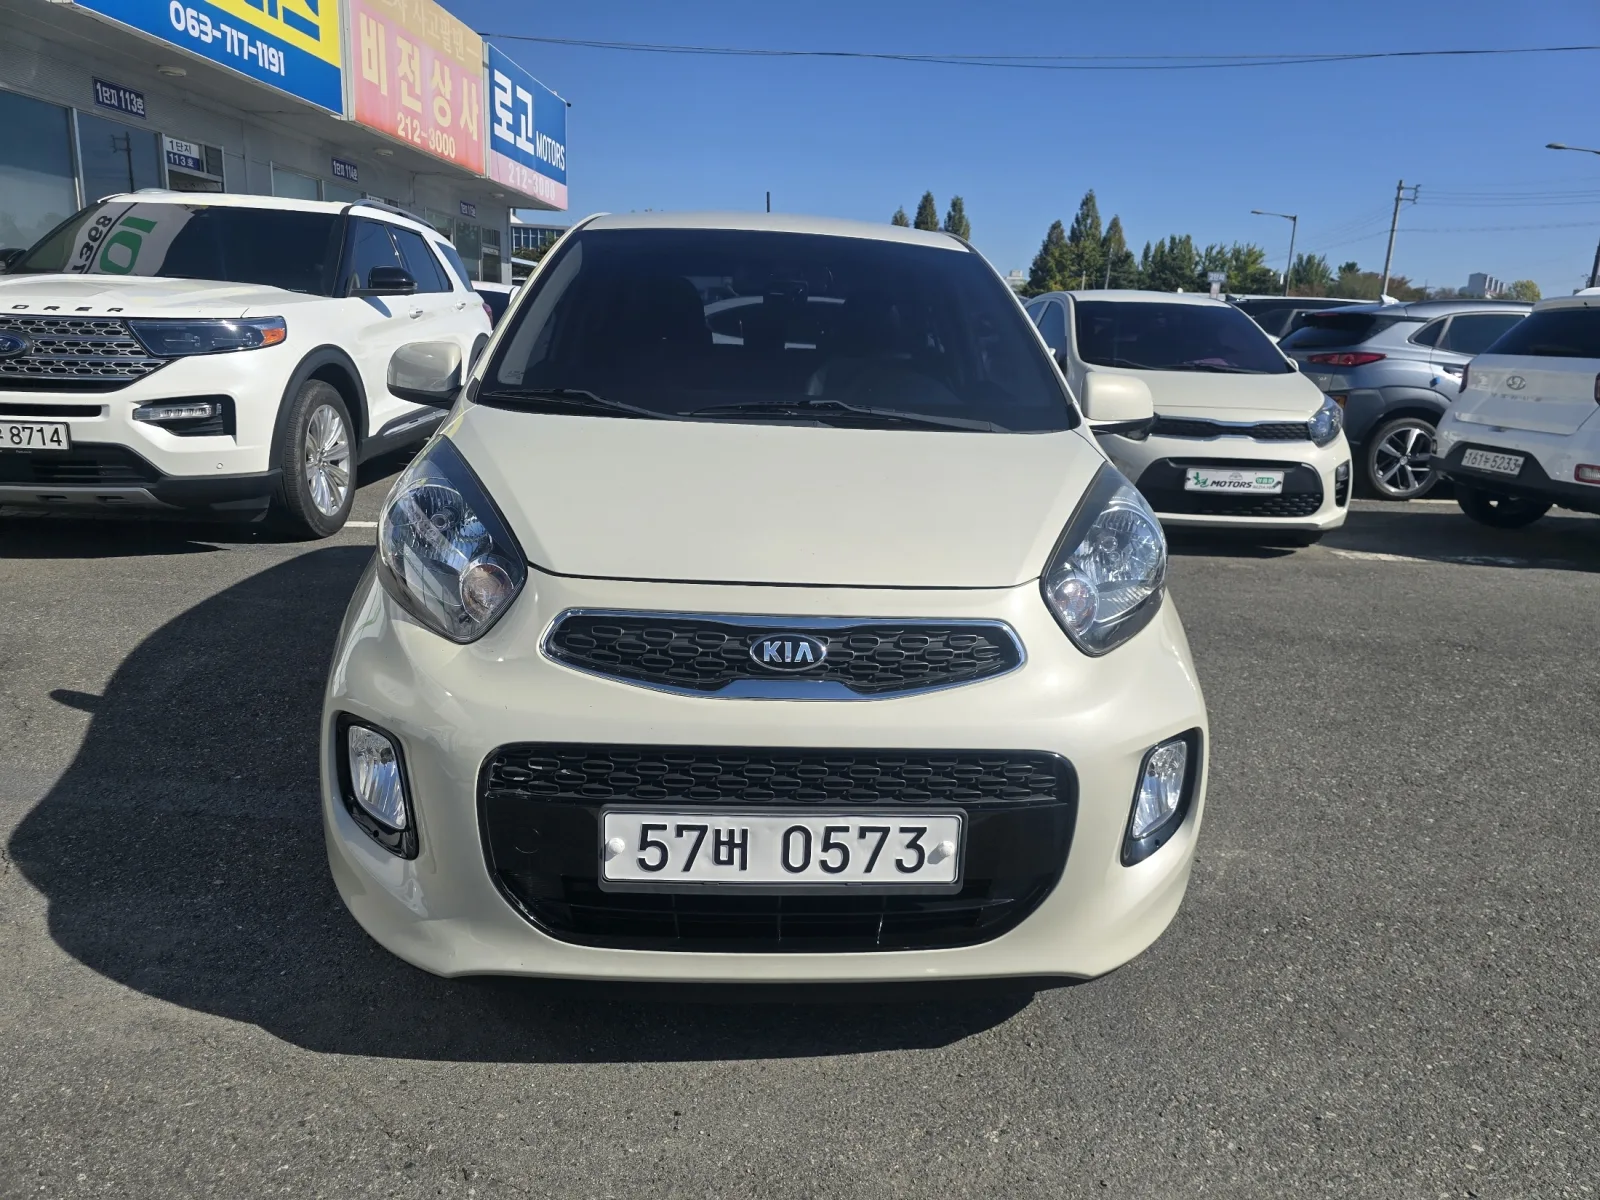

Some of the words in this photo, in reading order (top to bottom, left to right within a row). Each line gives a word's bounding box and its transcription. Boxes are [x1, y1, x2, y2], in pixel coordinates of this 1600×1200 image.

[169, 0, 285, 76] 063-717-1191
[359, 11, 479, 141] 비전상사
[96, 82, 118, 107] 1단지
[120, 89, 145, 115] 113호
[397, 111, 456, 159] 212-3000
[493, 68, 535, 155] 로고
[536, 130, 565, 172] MOTORS
[168, 153, 194, 167] 113호
[169, 140, 192, 155] 1단지
[508, 161, 556, 201] 212-3000
[9, 425, 63, 447] 8714
[1490, 454, 1519, 472] 5233
[1210, 480, 1253, 489] MOTORS
[763, 641, 815, 663] KIA
[636, 823, 749, 873] 57버
[780, 824, 928, 874] 0573
